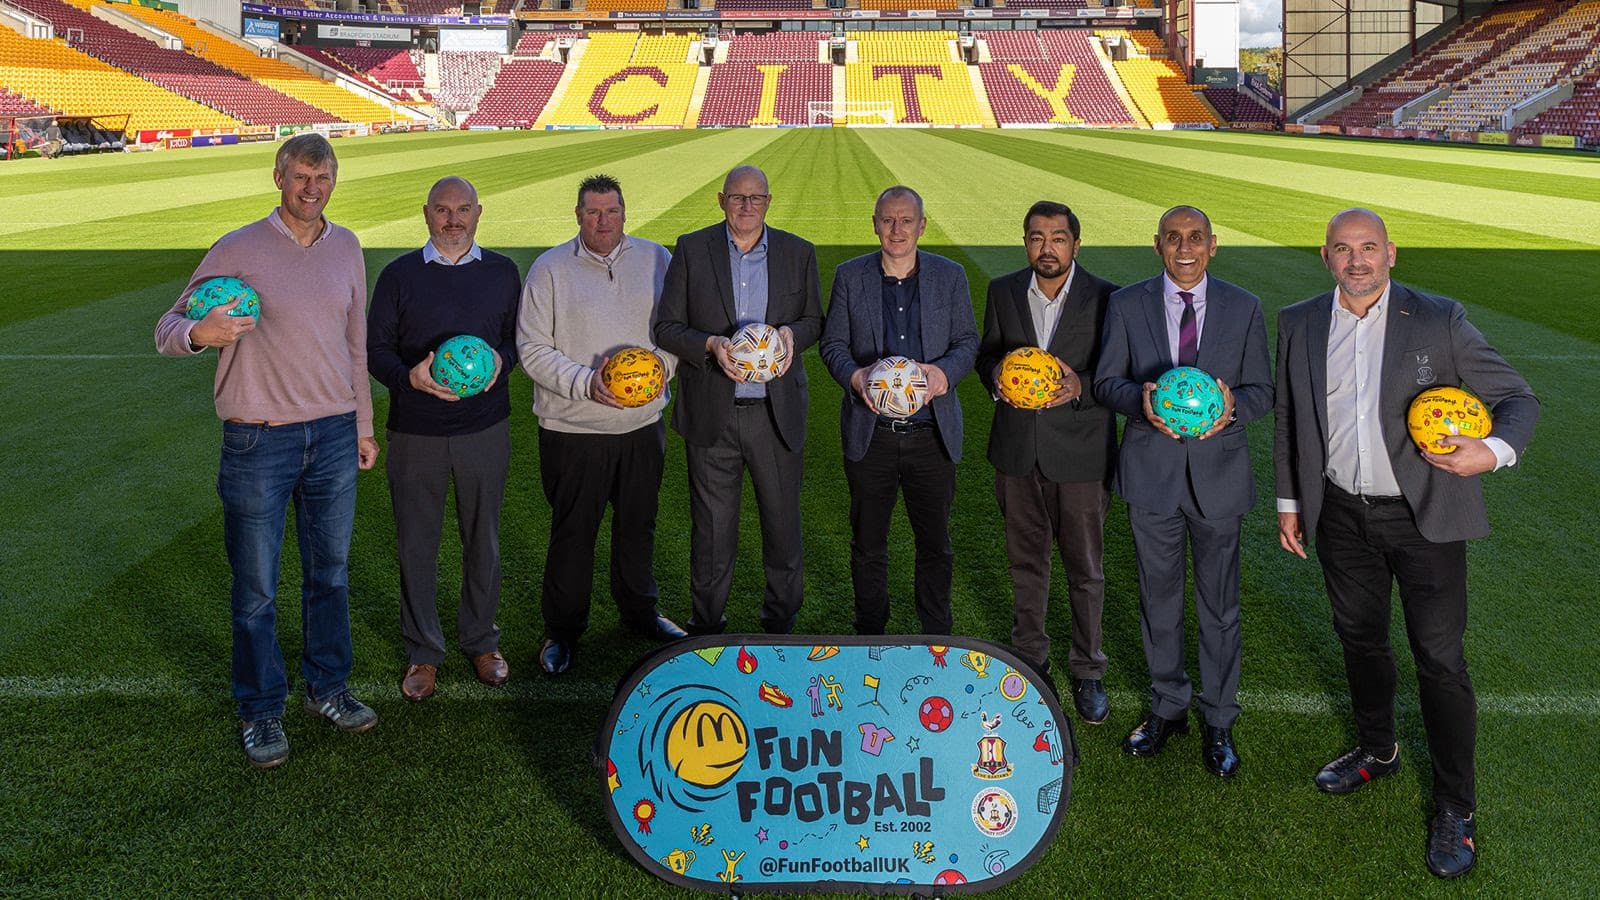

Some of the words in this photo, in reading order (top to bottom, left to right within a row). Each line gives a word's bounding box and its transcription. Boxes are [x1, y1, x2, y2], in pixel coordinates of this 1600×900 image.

[282, 8, 300, 16] Smith
[303, 9, 322, 18] Butler
[325, 12, 369, 20] Accountants
[372, 31, 399, 39] STADIUM
[587, 63, 1083, 124] CITY
[754, 728, 842, 772] FUN
[736, 757, 945, 825] FOOTBALL
[874, 821, 898, 833] Est.
[900, 821, 931, 833] 2002
[759, 857, 911, 877] @FunFootballUK
